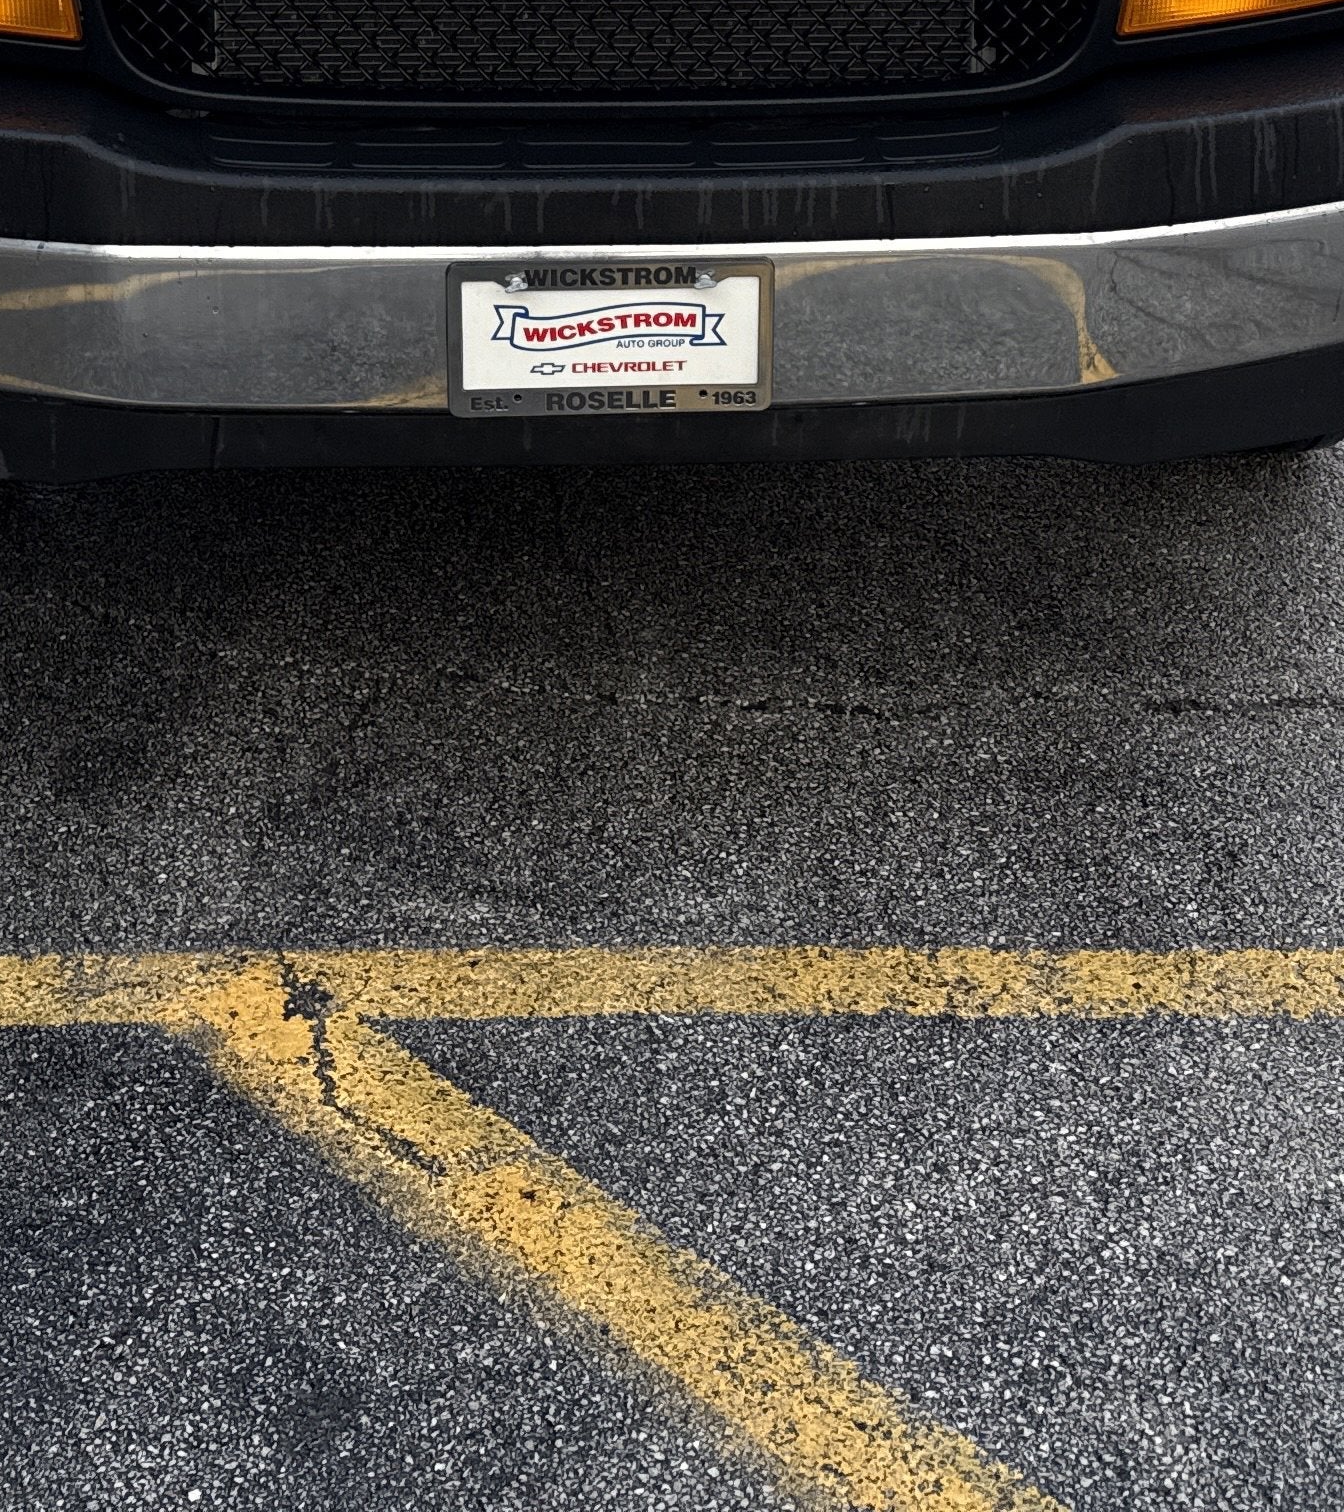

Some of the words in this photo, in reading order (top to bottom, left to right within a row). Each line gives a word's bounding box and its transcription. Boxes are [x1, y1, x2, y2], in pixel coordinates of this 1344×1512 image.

[524, 266, 697, 288] WICKSTROM
[522, 312, 697, 343] WICKSTROM
[616, 339, 645, 349] AUTO
[648, 338, 685, 349] GROUP
[571, 360, 688, 374] CHEVROLET
[470, 396, 509, 412] Est.
[546, 390, 677, 412] ROSELLE
[711, 391, 757, 407] 1963
